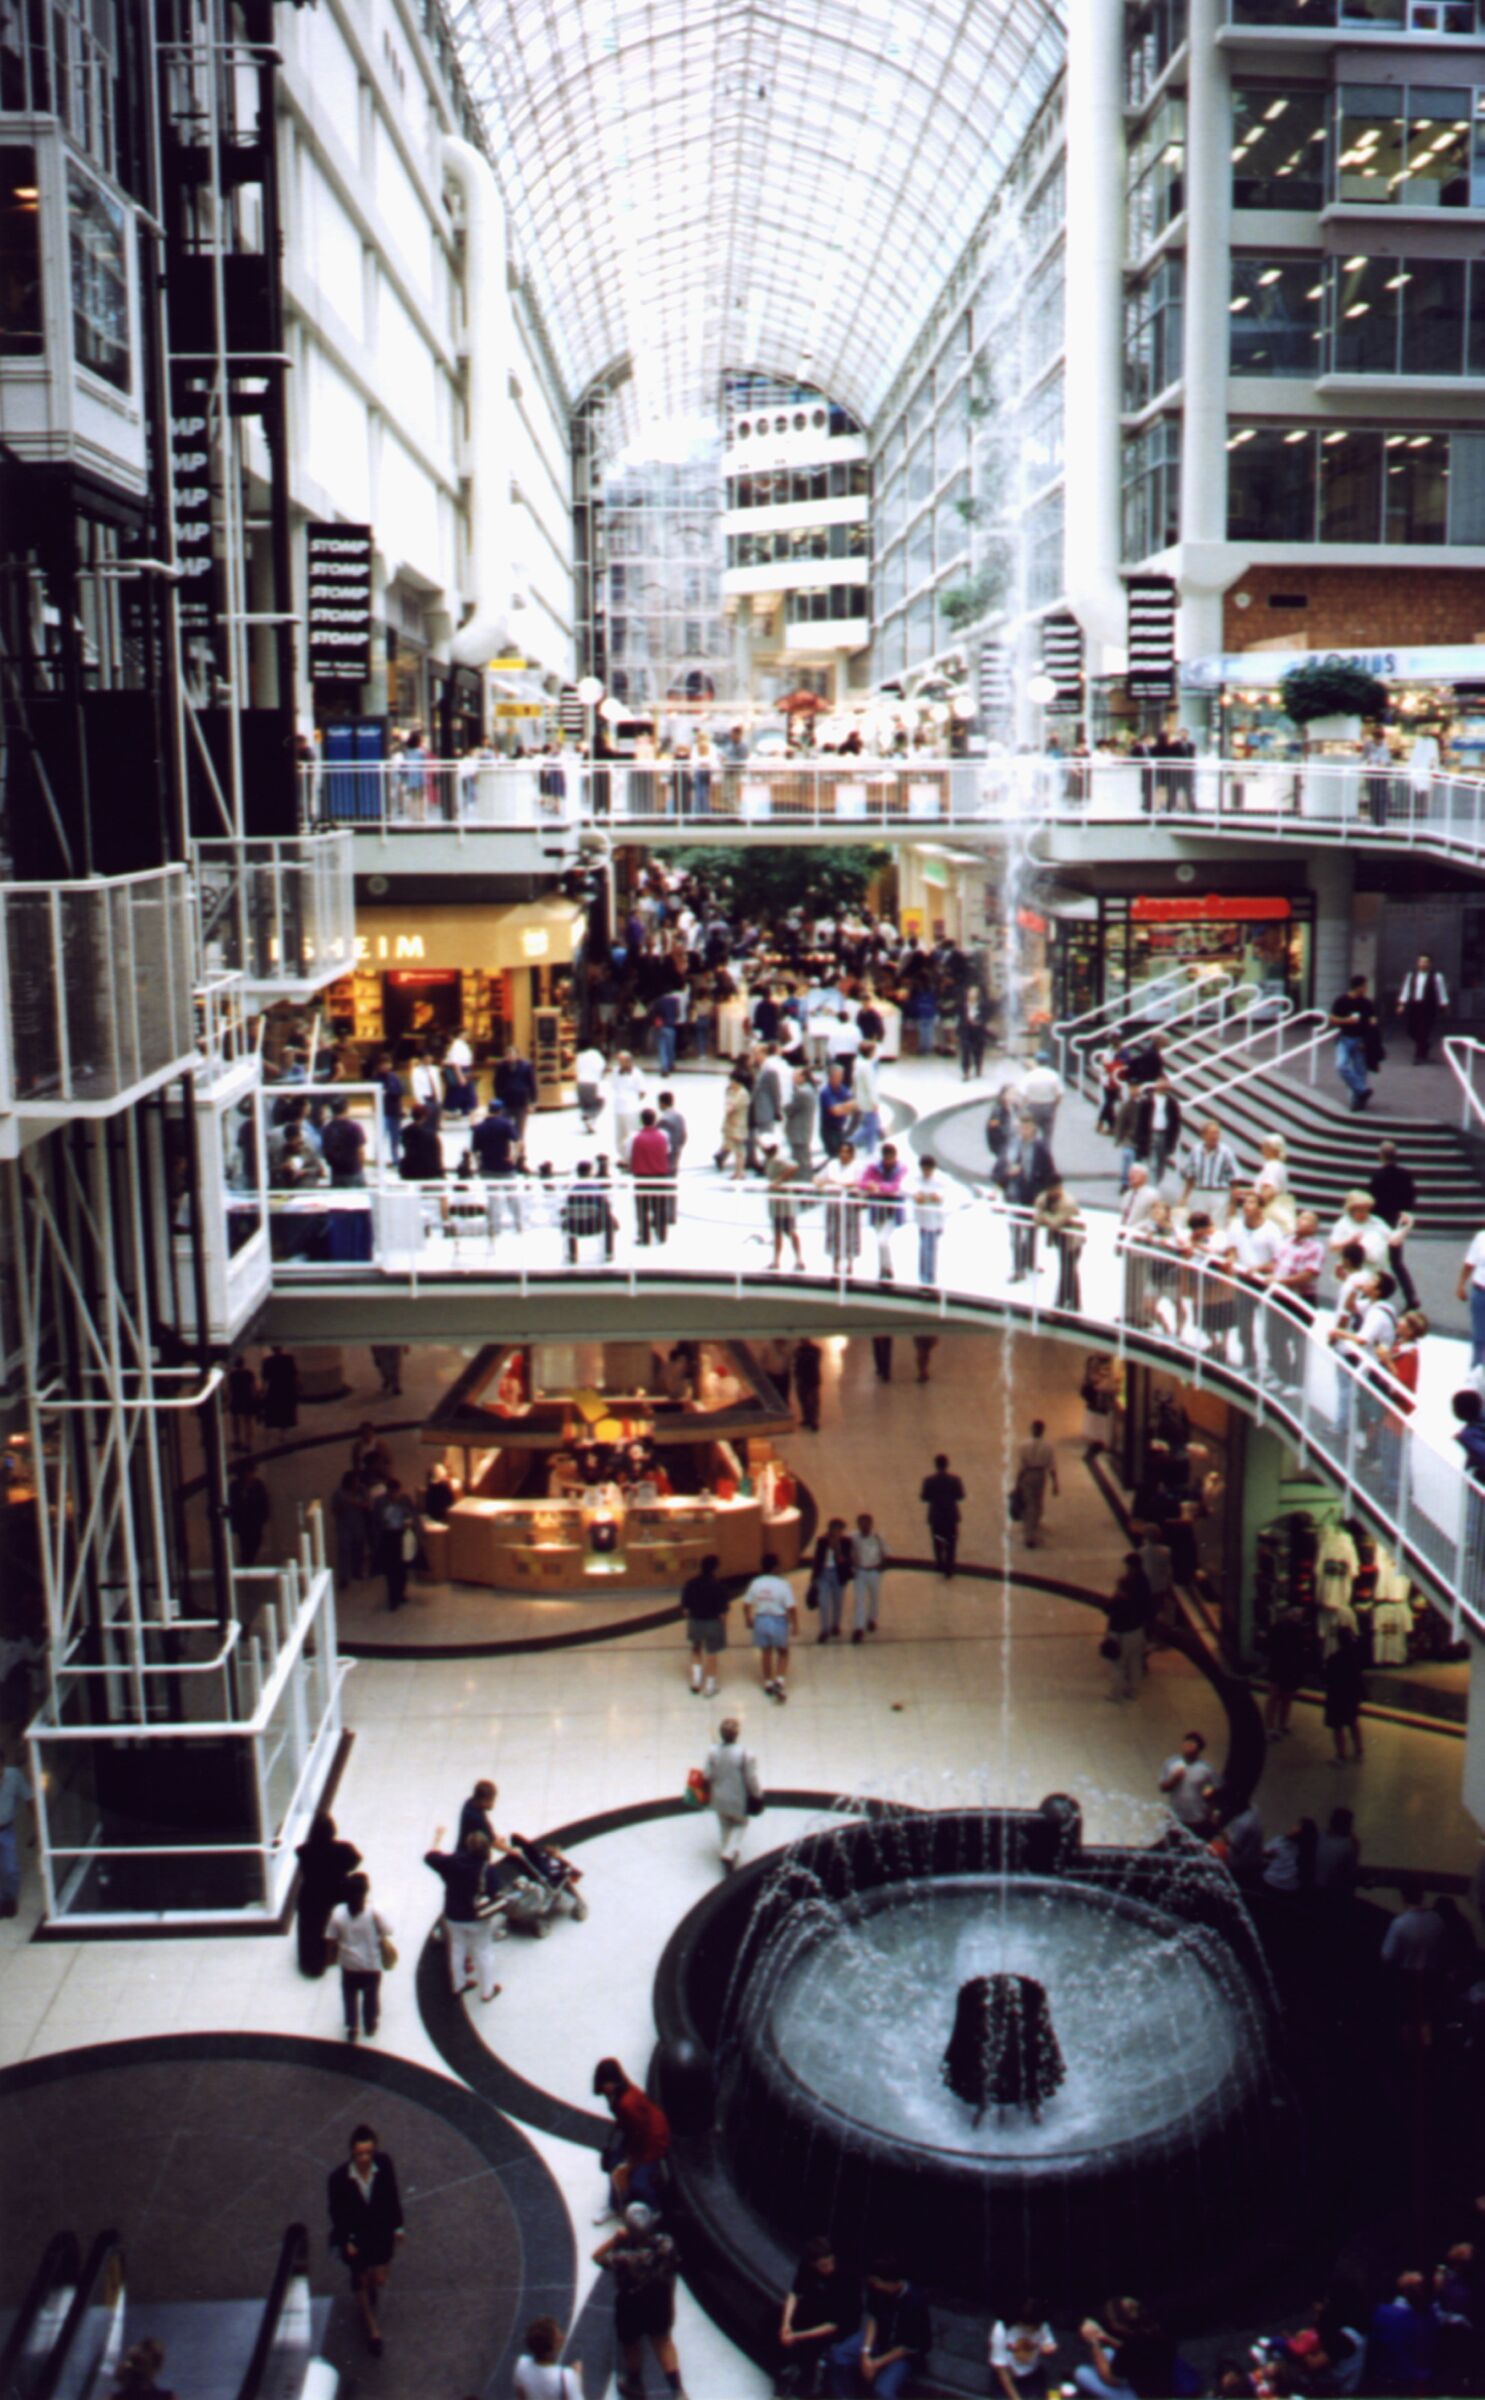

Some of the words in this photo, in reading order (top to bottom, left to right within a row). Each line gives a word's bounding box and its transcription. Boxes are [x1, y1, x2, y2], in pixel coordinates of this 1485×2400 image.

[310, 539, 370, 554] STOMP
[310, 561, 370, 576] STOMP
[310, 585, 370, 600] STOMP
[310, 608, 370, 623] STOMP
[310, 630, 370, 645] STOMP
